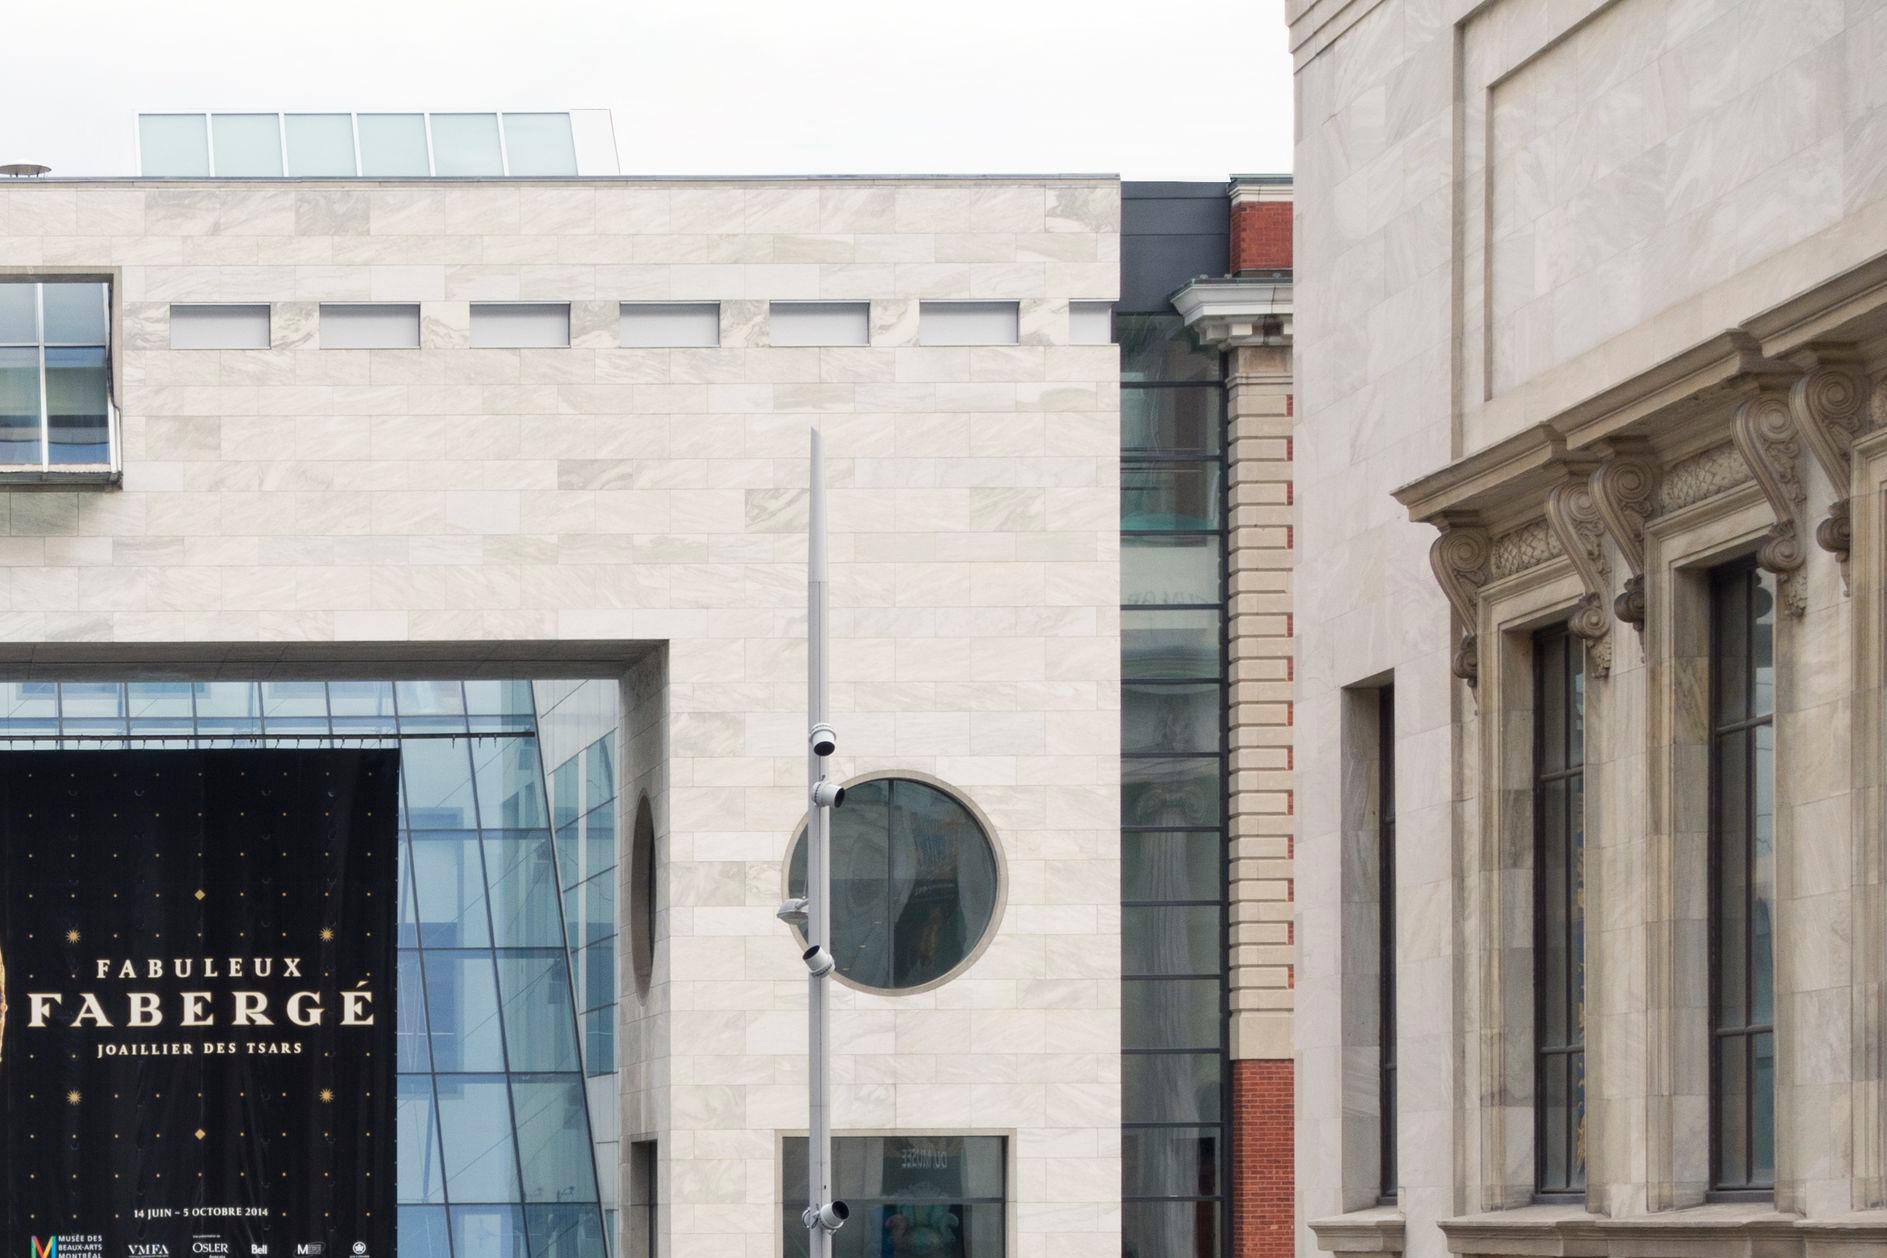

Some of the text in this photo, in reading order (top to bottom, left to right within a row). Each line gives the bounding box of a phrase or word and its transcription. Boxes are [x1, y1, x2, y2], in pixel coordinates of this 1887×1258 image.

[96, 957, 302, 979] FABULEUX
[27, 980, 374, 1028] FABERGÉ
[97, 1042, 302, 1059] JOAILLIER DES TSARS
[134, 1209, 145, 1218] 14
[148, 1208, 172, 1220] JUIN
[183, 1208, 189, 1217] 5
[192, 1207, 242, 1217] OCTOBRE
[245, 1207, 269, 1217] 2014
[58, 1233, 103, 1243] MUSÉE DES
[58, 1243, 103, 1252] BEAUX-ARTS
[127, 1244, 170, 1256] VMFA
[192, 1241, 229, 1255] OSLER
[251, 1244, 268, 1255] Bell
